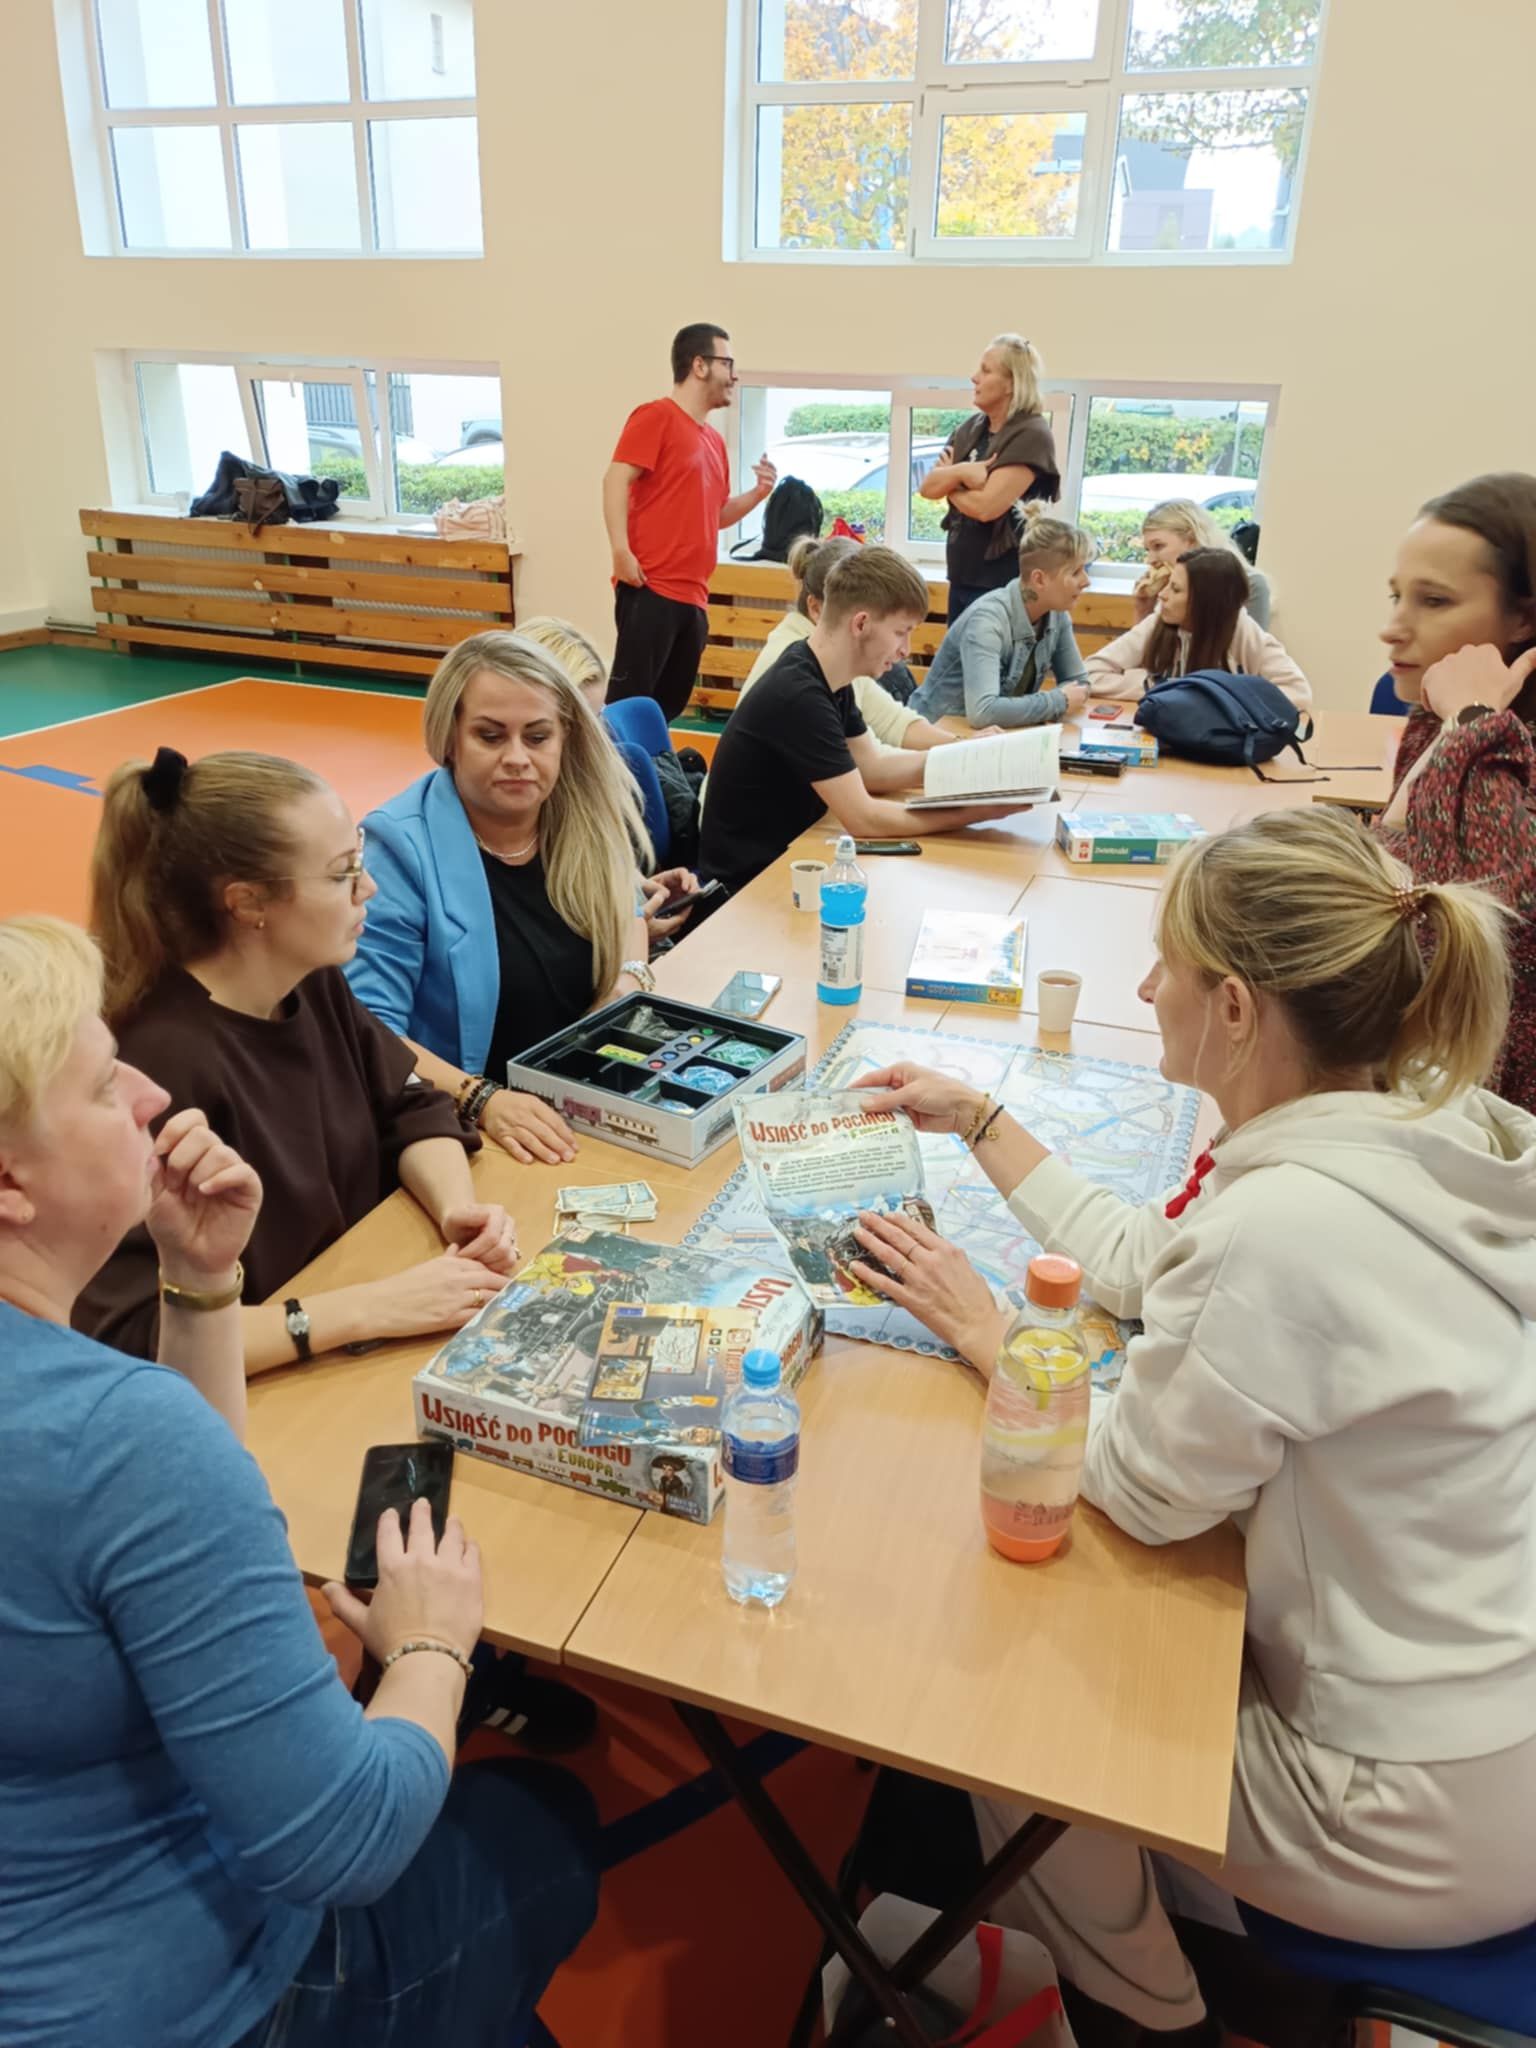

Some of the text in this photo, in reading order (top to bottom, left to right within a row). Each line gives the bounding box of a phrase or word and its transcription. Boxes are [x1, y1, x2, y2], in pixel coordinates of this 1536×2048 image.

[810, 1121, 829, 1136] DO
[421, 1393, 501, 1441] WSIĄŚĆ
[506, 1424, 532, 1445] DO
[558, 1448, 613, 1477] EUROPA
